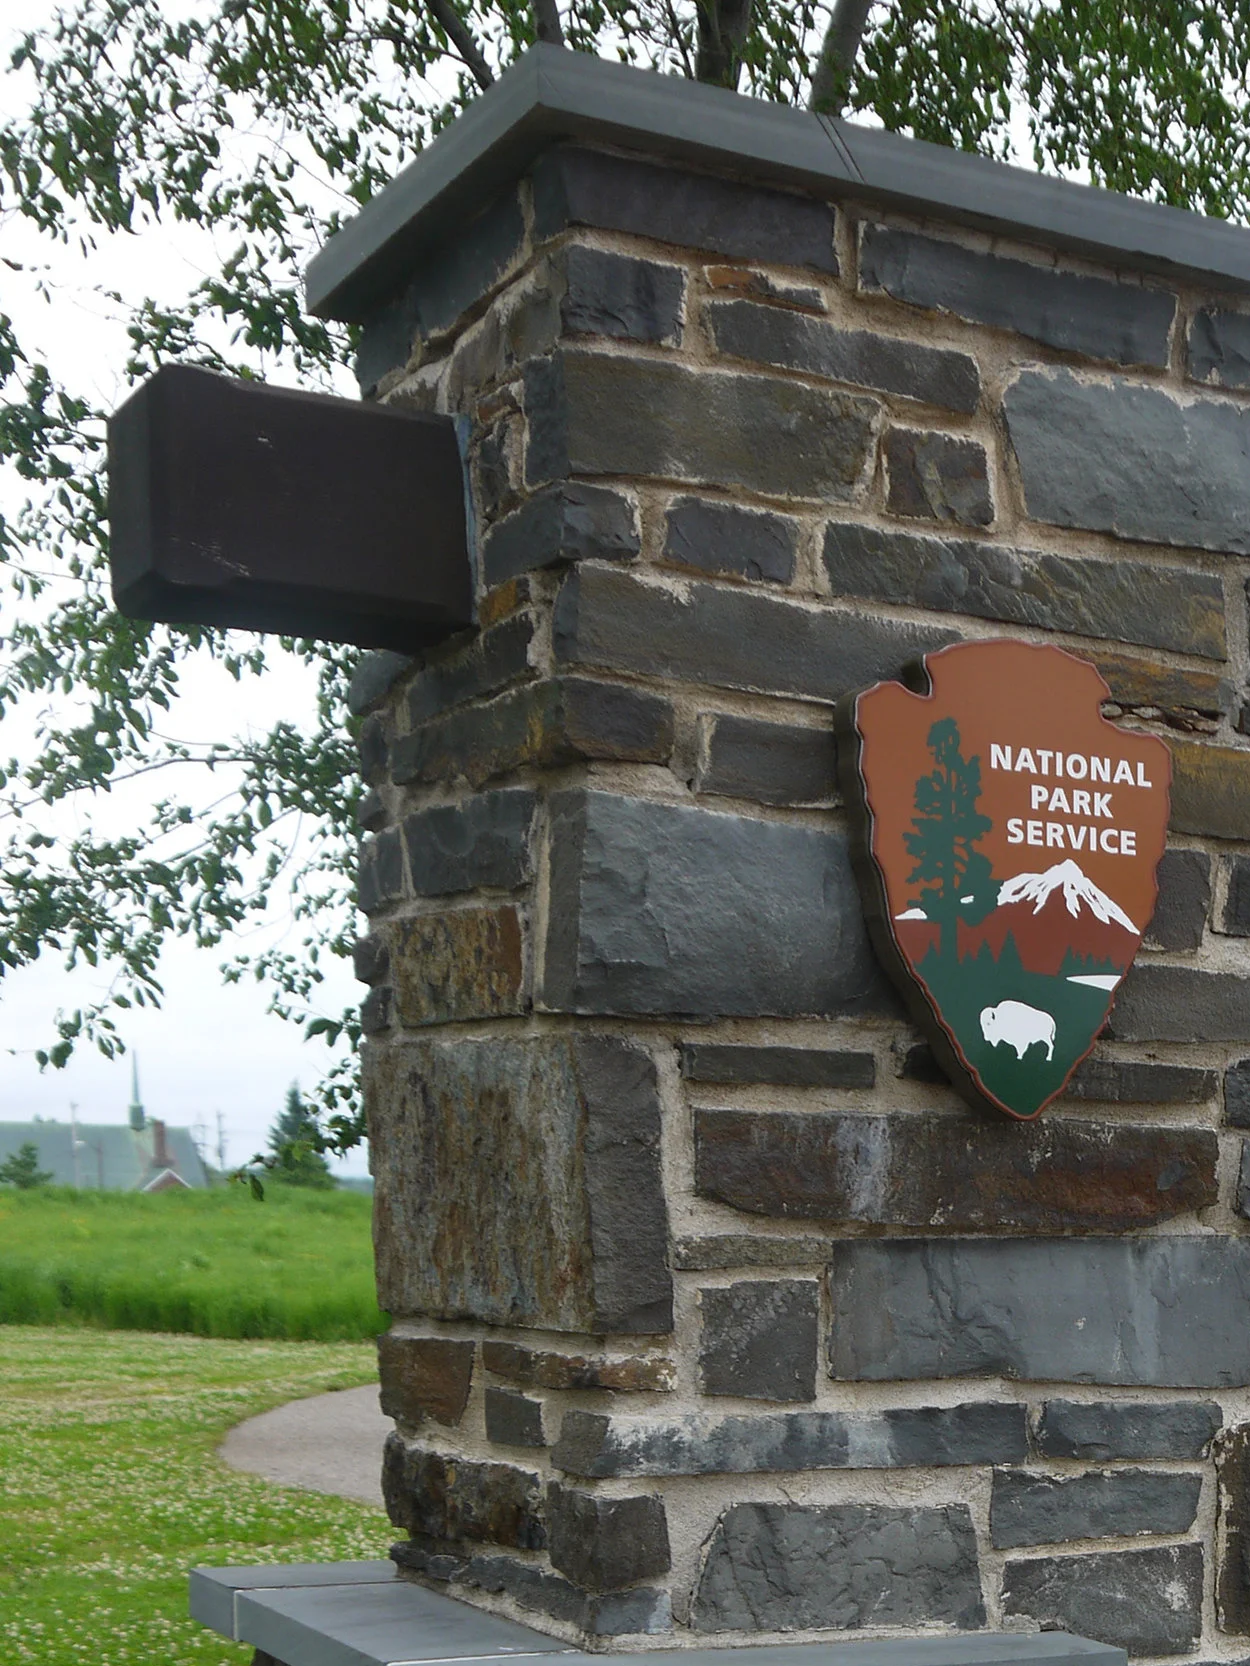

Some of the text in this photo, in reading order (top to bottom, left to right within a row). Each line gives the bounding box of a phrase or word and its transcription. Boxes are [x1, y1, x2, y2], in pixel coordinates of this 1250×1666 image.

[990, 743, 1152, 787] NATIONAL
[1030, 785, 1113, 818] PARK
[1006, 818, 1137, 856] SERVICE
